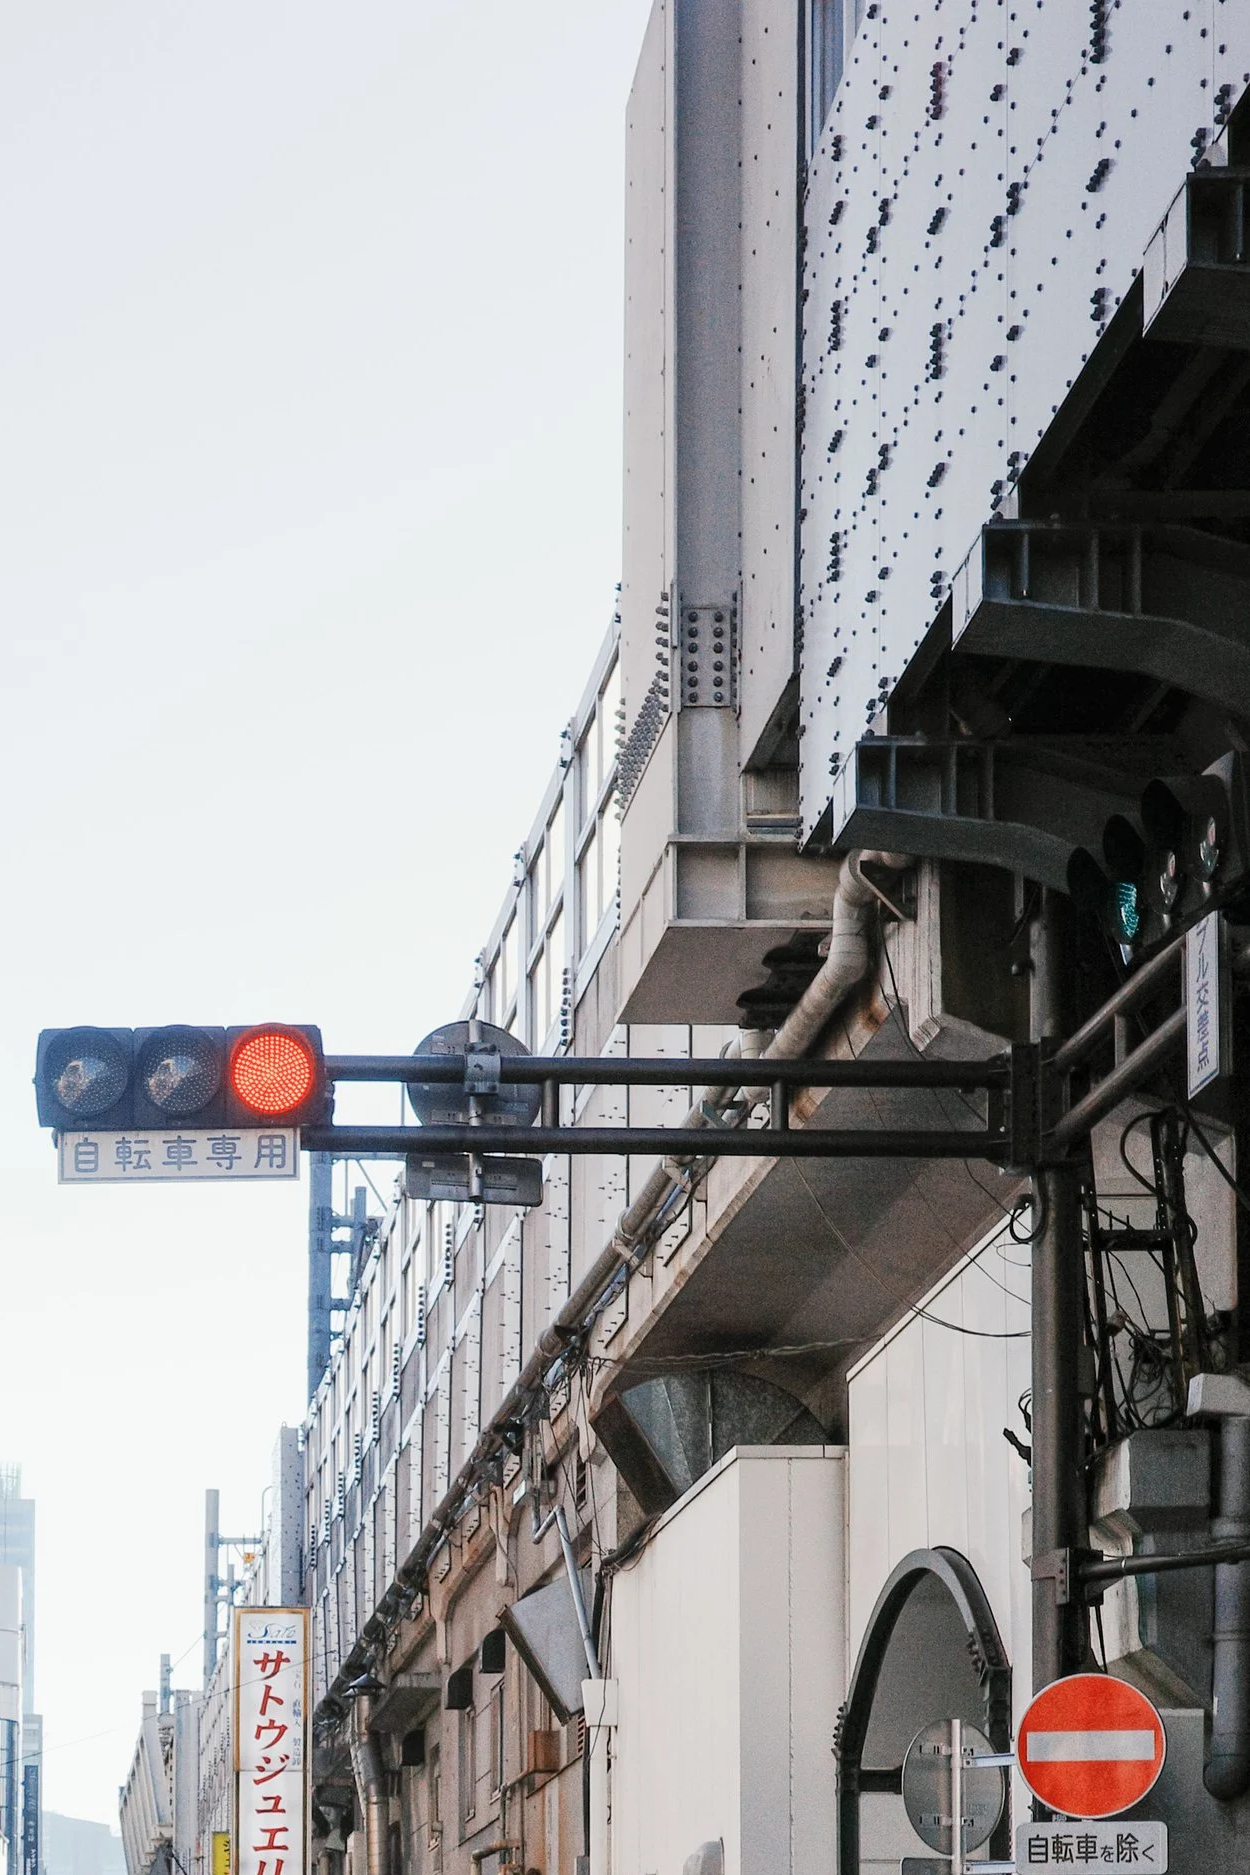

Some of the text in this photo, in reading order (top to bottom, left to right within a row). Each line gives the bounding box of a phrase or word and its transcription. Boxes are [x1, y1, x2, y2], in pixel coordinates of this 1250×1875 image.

[73, 1134, 288, 1174] 自転車専用
[1028, 1832, 1155, 1864] 自転車を除く
